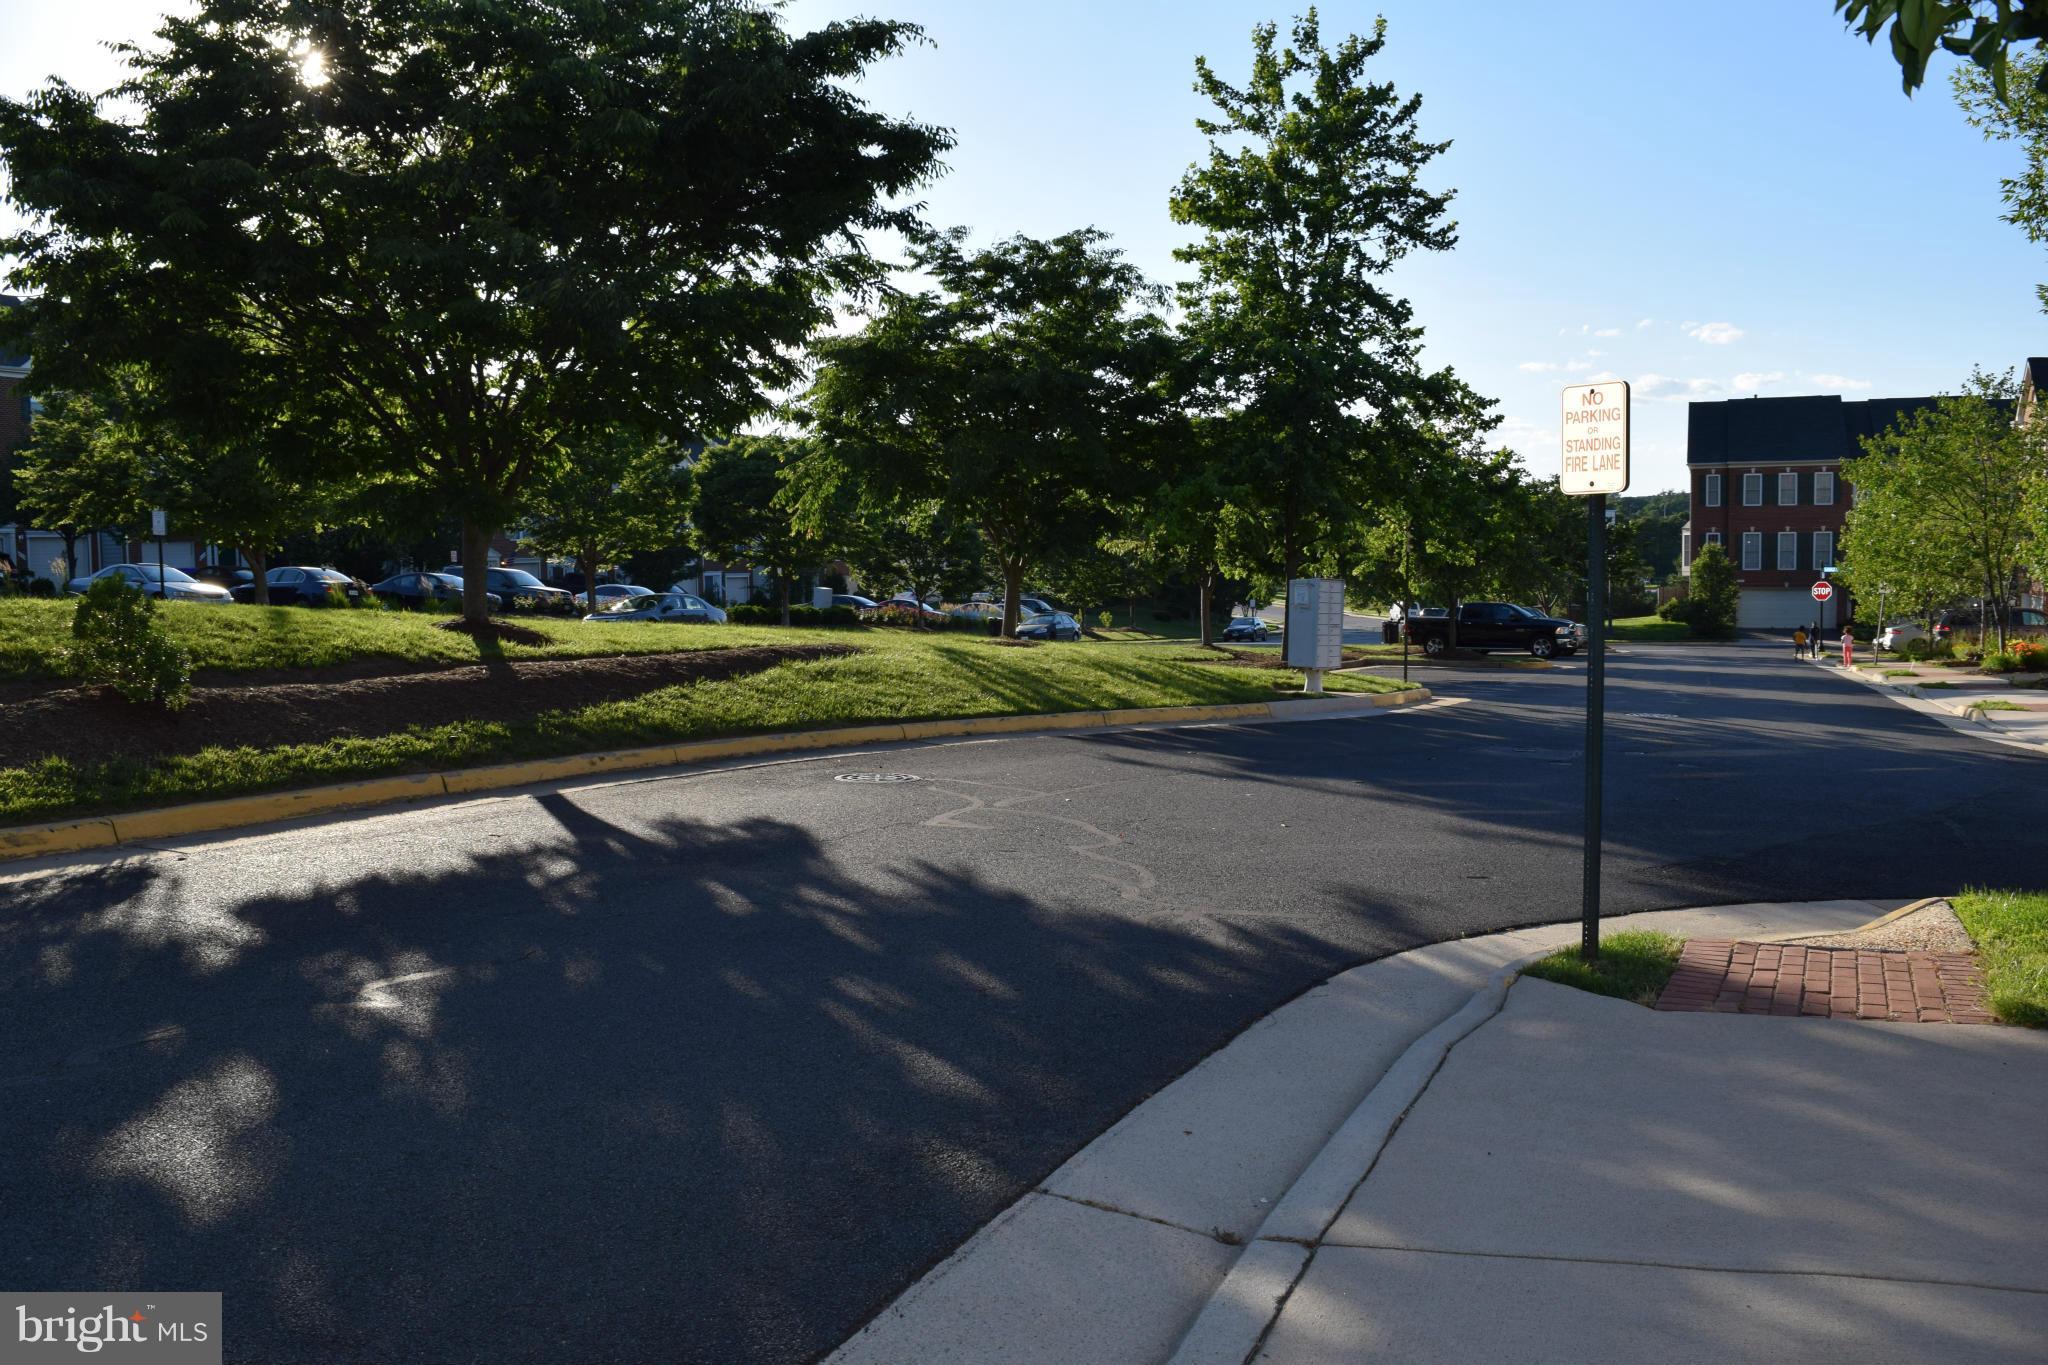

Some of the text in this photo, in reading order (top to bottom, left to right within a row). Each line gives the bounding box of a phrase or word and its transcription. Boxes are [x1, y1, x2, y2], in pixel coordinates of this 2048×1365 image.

[1582, 391, 1604, 406] NO
[1565, 407, 1621, 425] PARKING
[1587, 426, 1599, 435] OR
[1565, 436, 1621, 453] STANDING
[1565, 453, 1621, 472] FIRE LANE
[1813, 587, 1831, 595] STOP
